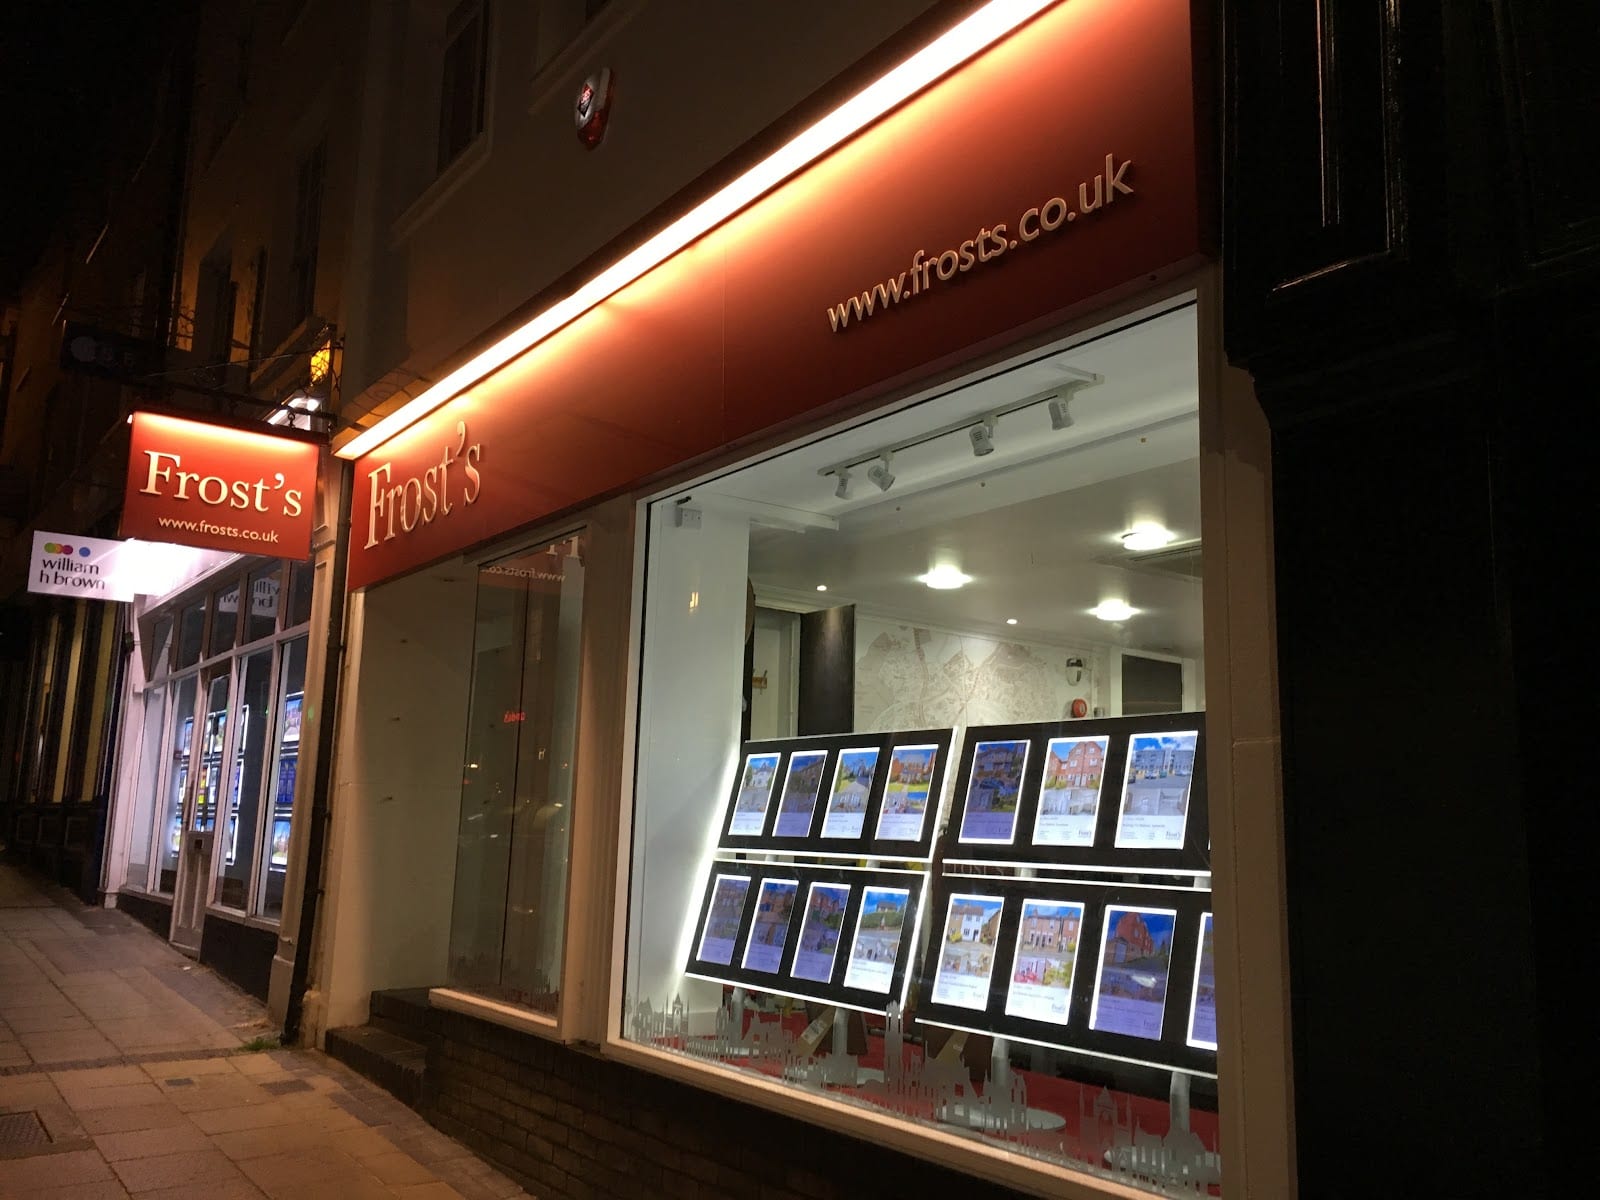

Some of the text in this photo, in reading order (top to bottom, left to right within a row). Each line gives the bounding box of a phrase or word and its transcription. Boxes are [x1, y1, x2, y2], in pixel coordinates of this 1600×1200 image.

[827, 153, 1134, 332] www.frosts.co.uk
[139, 450, 302, 517] Frost's
[364, 420, 482, 549] Frost's
[158, 517, 279, 543] www.frosts.co.uk
[39, 570, 105, 590] h brown
[42, 558, 99, 575] william
